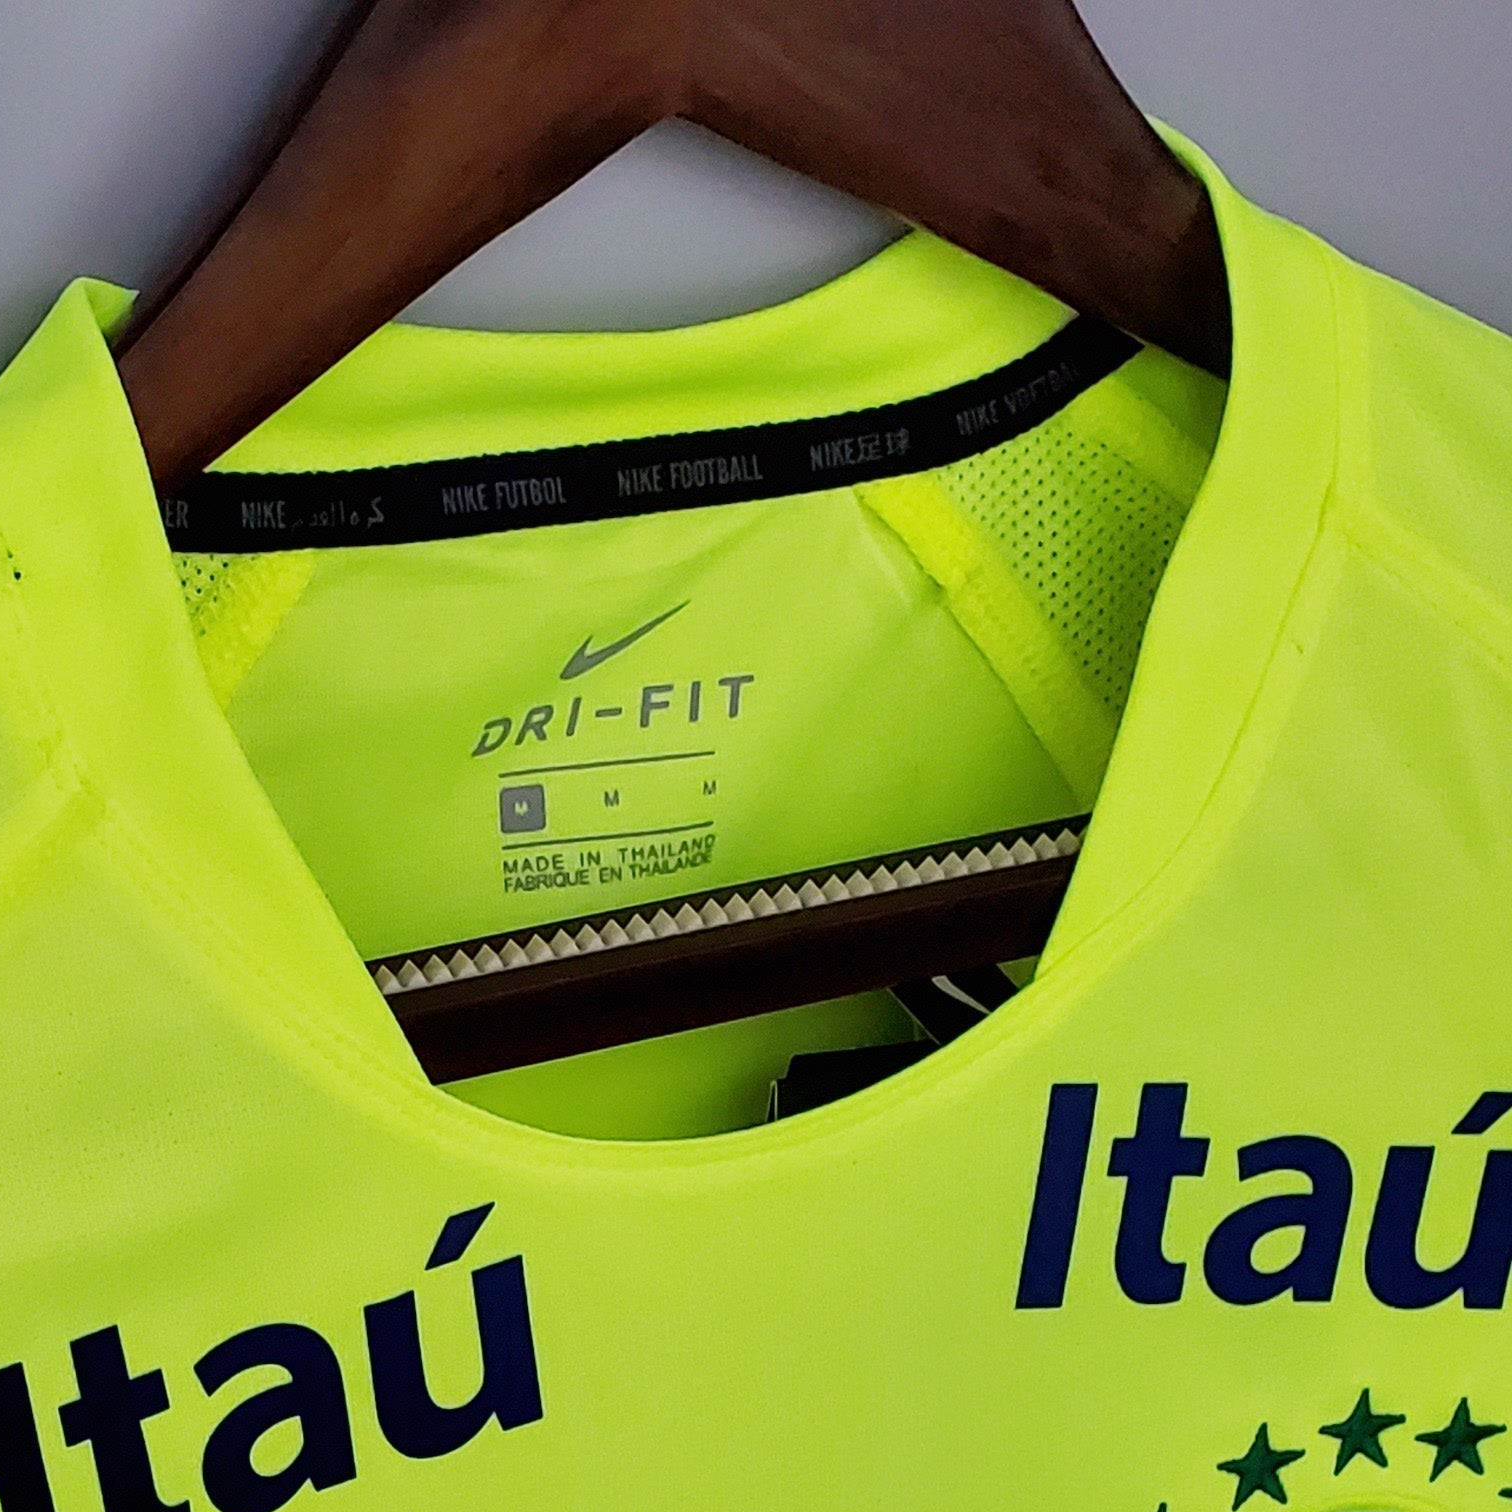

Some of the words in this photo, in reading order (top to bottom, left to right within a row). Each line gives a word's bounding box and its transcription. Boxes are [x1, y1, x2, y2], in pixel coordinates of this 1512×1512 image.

[955, 398, 1000, 436] NIKE
[441, 483, 488, 515] NIKE
[494, 476, 567, 510] FUTBOL
[616, 463, 663, 498] NIKE
[669, 453, 764, 490] FOOTBALL
[241, 500, 287, 529] NIKE
[471, 674, 755, 757] DRI-FIT
[603, 789, 620, 808] M
[702, 780, 717, 796] M
[502, 853, 566, 875] MADE
[579, 850, 601, 868] IN
[619, 833, 716, 864] THAILAND
[504, 867, 591, 893] FABRIQUE
[599, 866, 622, 885] EN
[629, 851, 712, 879] THAILANDE
[1015, 1082, 1512, 1309] Itaú
